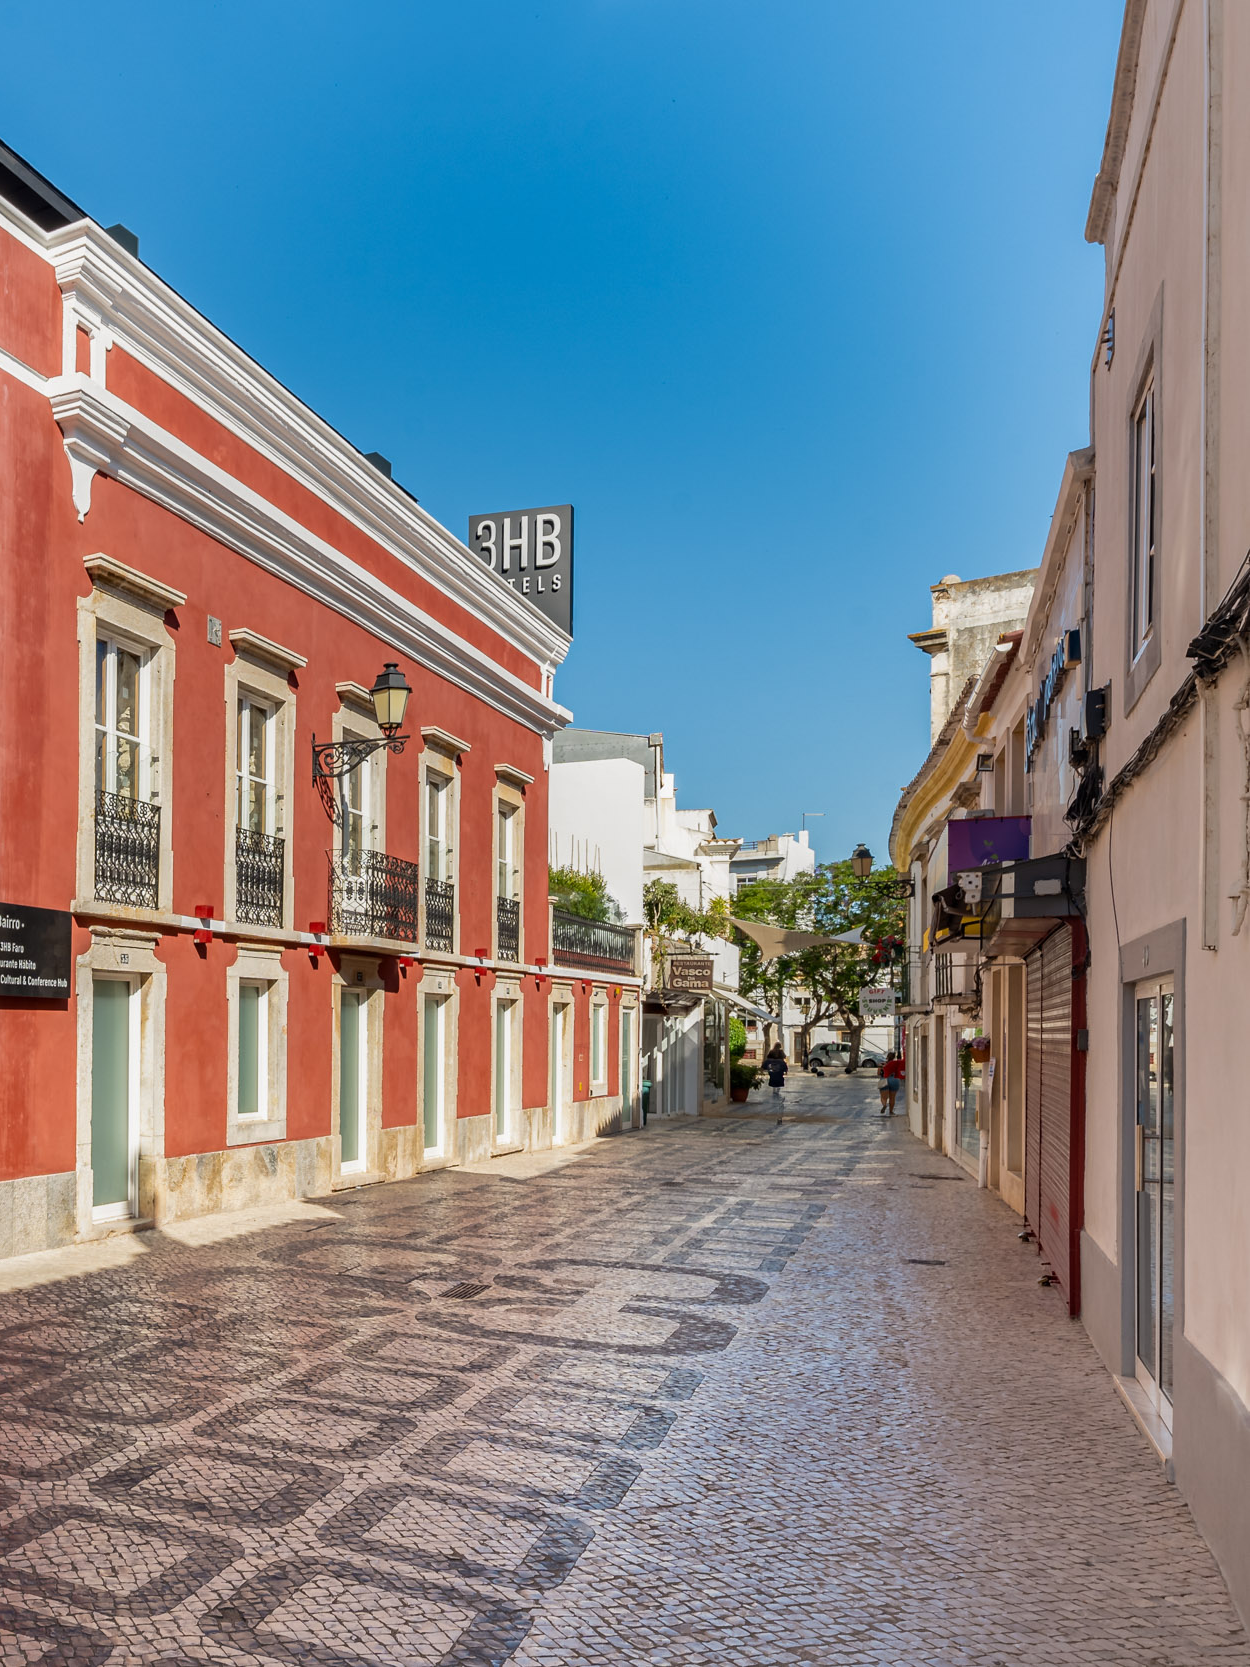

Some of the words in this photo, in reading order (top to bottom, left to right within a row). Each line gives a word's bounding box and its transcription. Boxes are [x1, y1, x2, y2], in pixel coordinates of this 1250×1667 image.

[477, 513, 562, 571] 3HB
[507, 574, 562, 593] TELS
[0, 941, 11, 952] 3HB
[12, 942, 25, 953] Faro
[672, 966, 711, 976] Vasco
[0, 974, 22, 985] Cultural
[27, 975, 57, 987] Conference
[57, 978, 68, 988] Hub
[672, 978, 709, 988] Gama
[862, 999, 892, 1014] SOUVENIR
